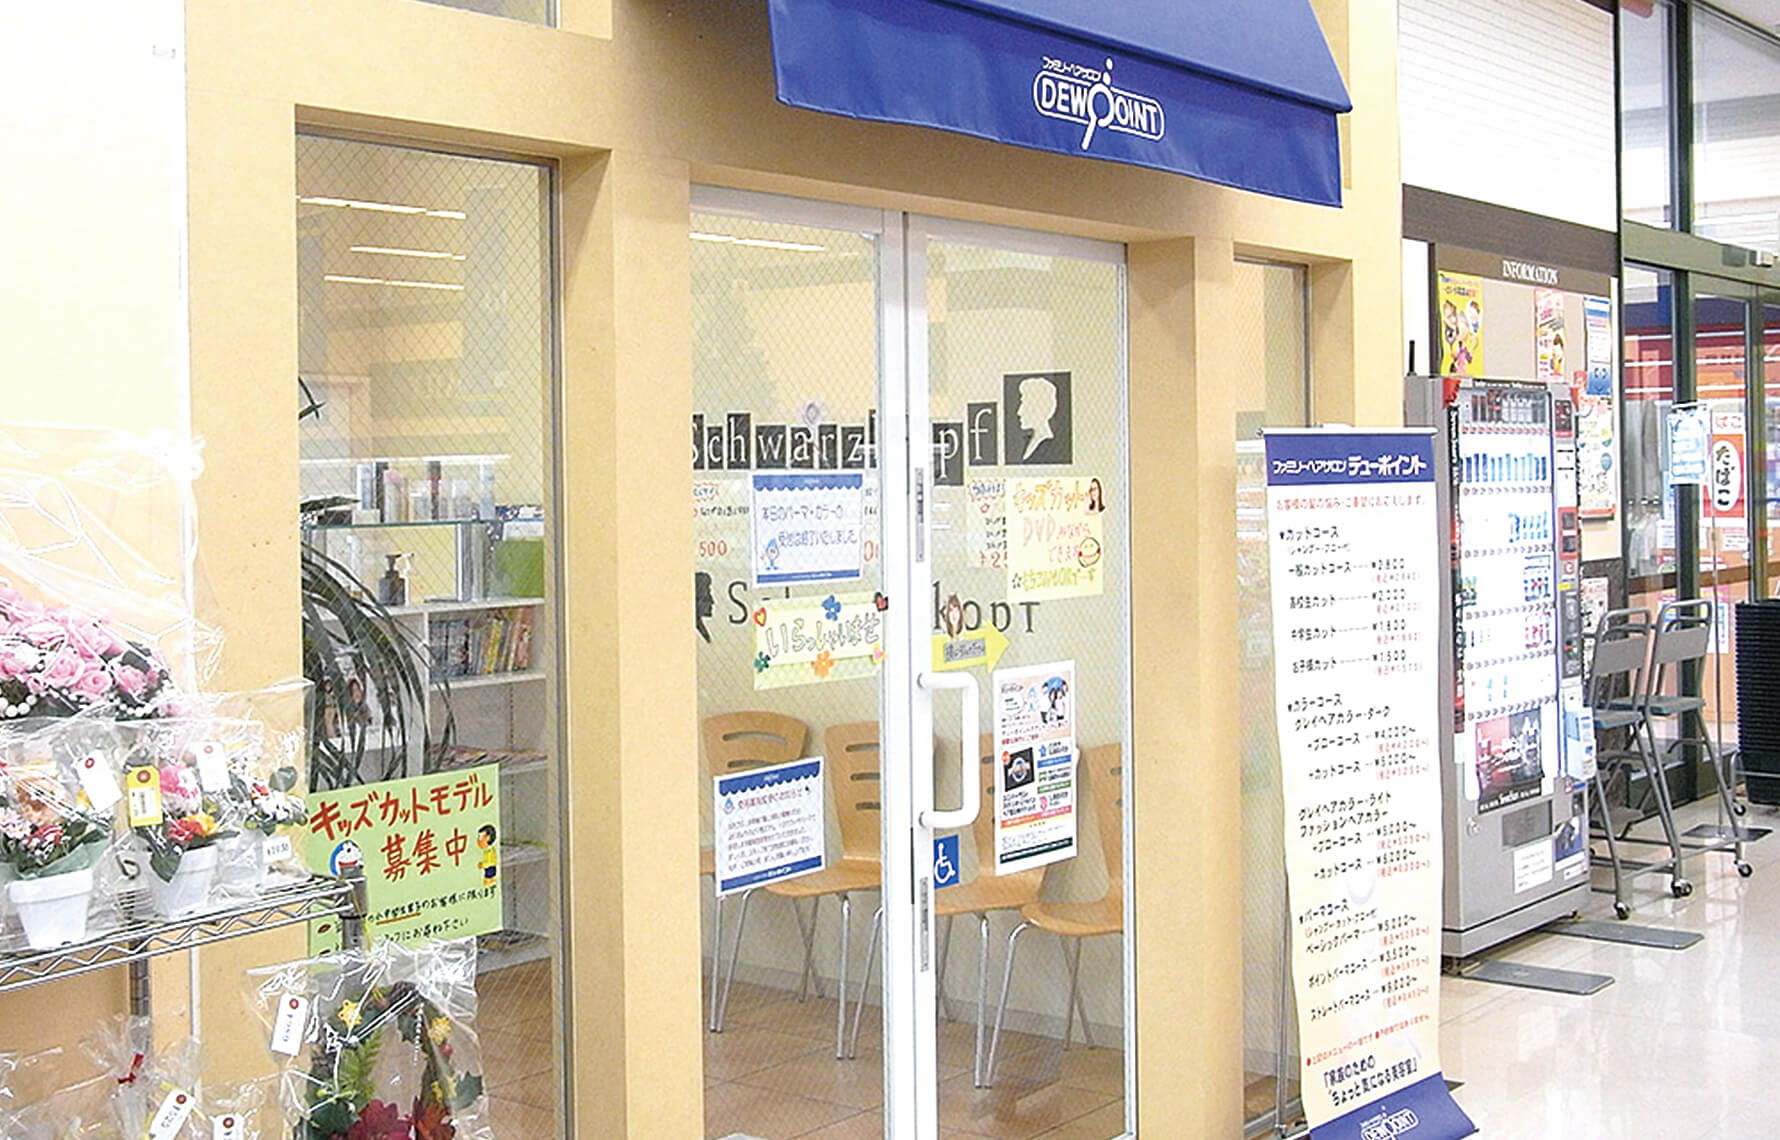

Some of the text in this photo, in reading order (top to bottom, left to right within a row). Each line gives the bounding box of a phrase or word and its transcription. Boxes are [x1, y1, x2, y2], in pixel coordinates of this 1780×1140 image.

[1348, 454, 1428, 476] デューポイント
[1716, 445, 1735, 506] たばこ
[699, 540, 728, 557] 500
[310, 773, 494, 841] キッズカットモデル
[380, 827, 468, 883] 募集中
